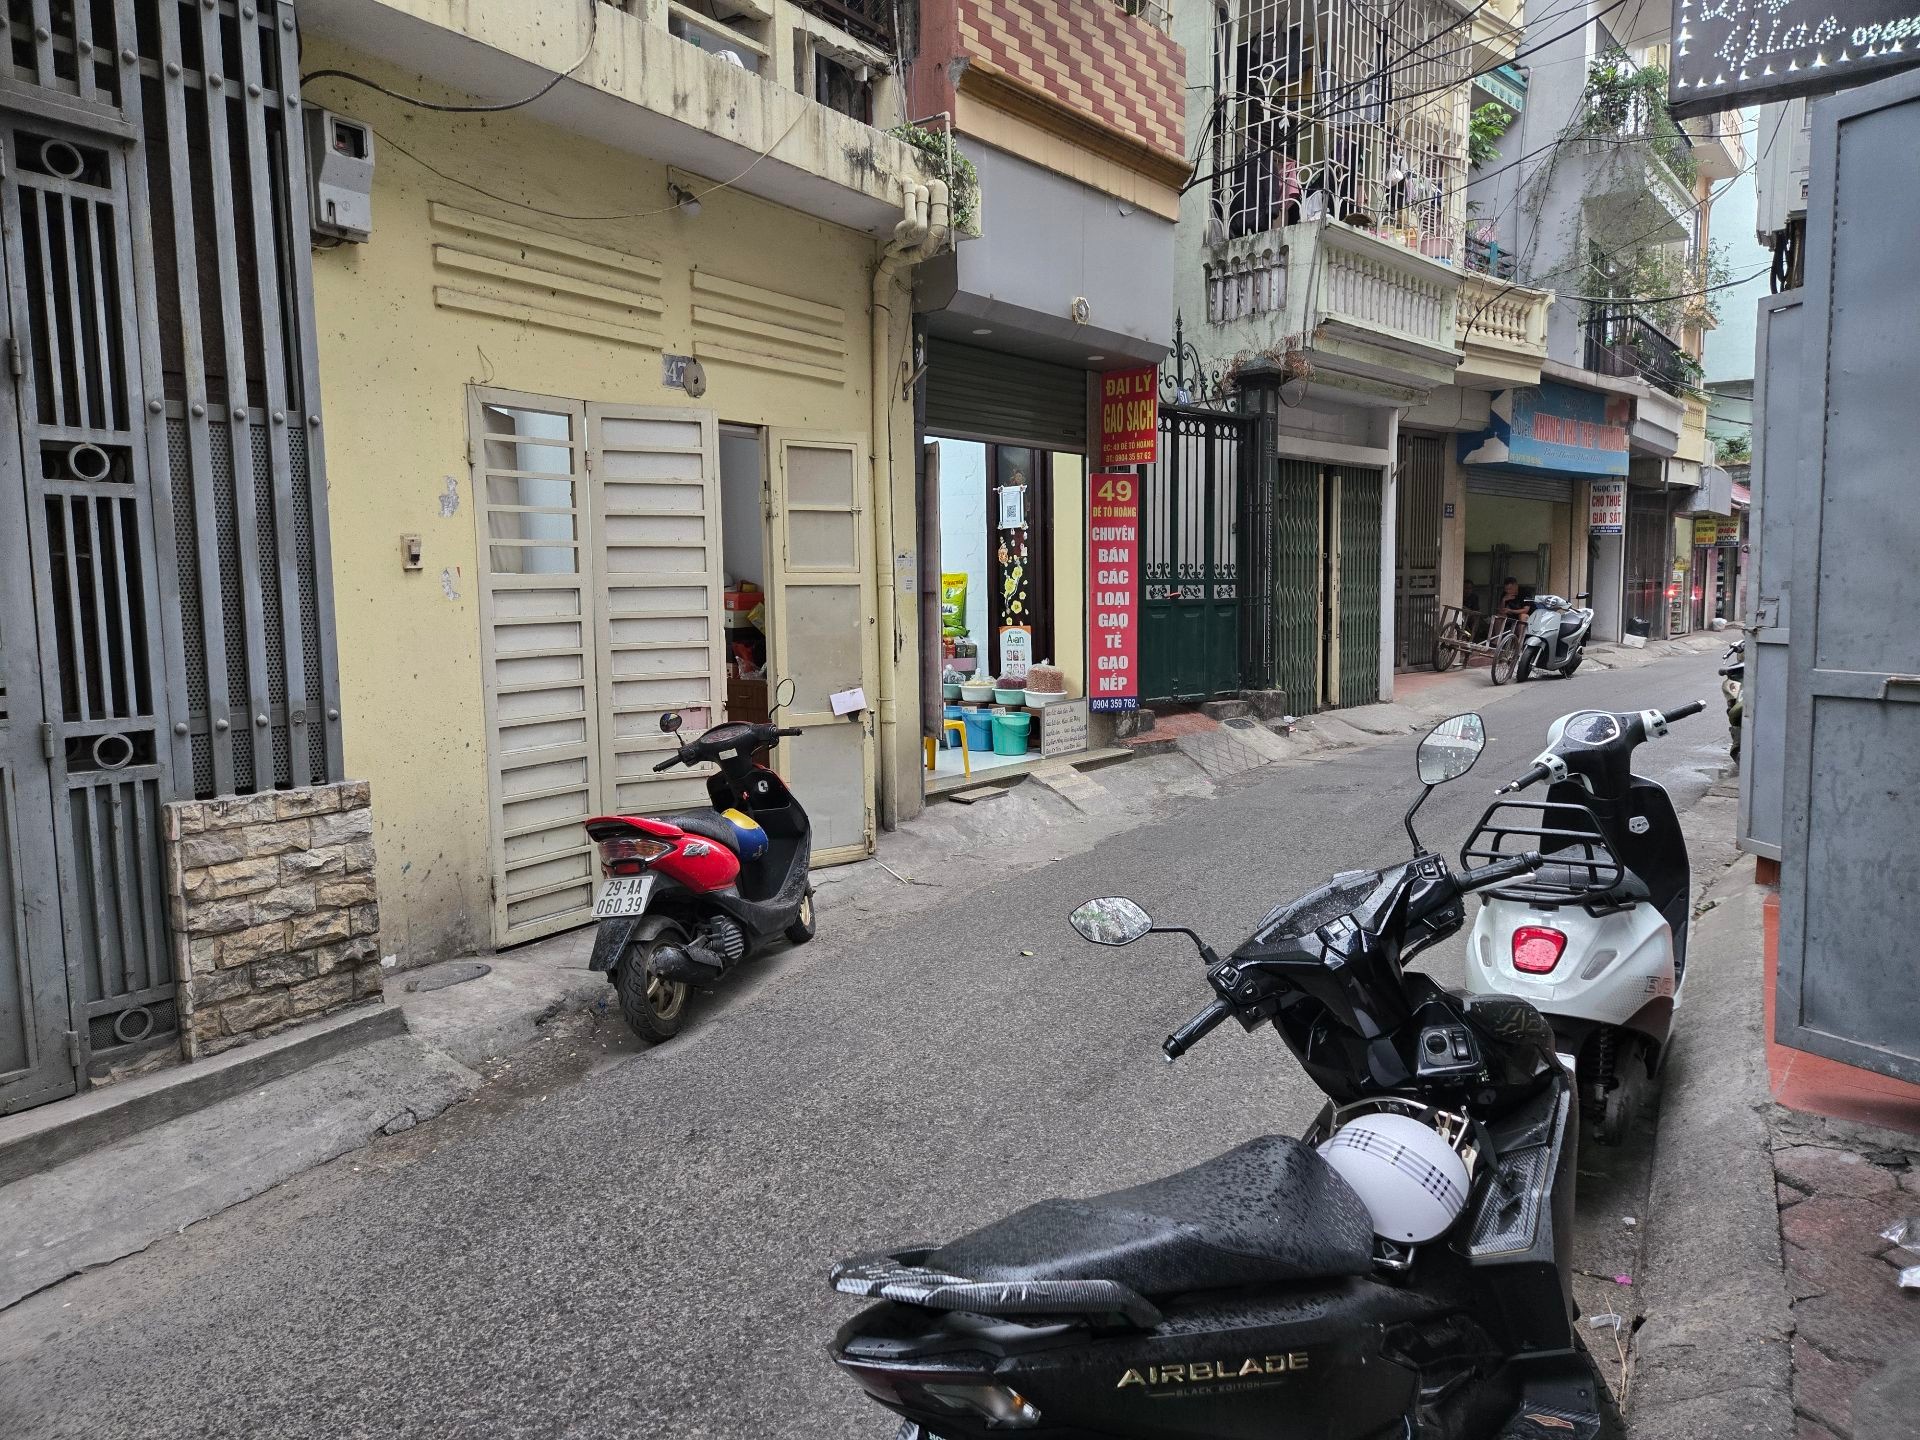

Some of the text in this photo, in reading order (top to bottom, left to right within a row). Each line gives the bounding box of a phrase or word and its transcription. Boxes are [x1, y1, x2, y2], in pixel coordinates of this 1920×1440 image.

[1106, 370, 1152, 399] ĐẠI LÝ
[1104, 399, 1154, 440] GẠO SẠCH
[1097, 480, 1132, 502] 49
[1113, 505, 1137, 518] HOÀNG
[1092, 524, 1135, 541] CHUYÊN
[1098, 547, 1129, 563] BÁN
[1098, 568, 1129, 585] CÁC
[1097, 591, 1130, 609] LOẠI
[1098, 613, 1129, 630] GẠO
[1098, 655, 1129, 672] GẠO
[1099, 672, 1128, 691] NẾP
[1092, 698, 1136, 711] 0904 359 762
[606, 879, 643, 897] 29-AA
[596, 897, 643, 915] 060.39
[1116, 1351, 1310, 1388] AIRBLADE
[1176, 1381, 1261, 1397] BLACK EDITION
